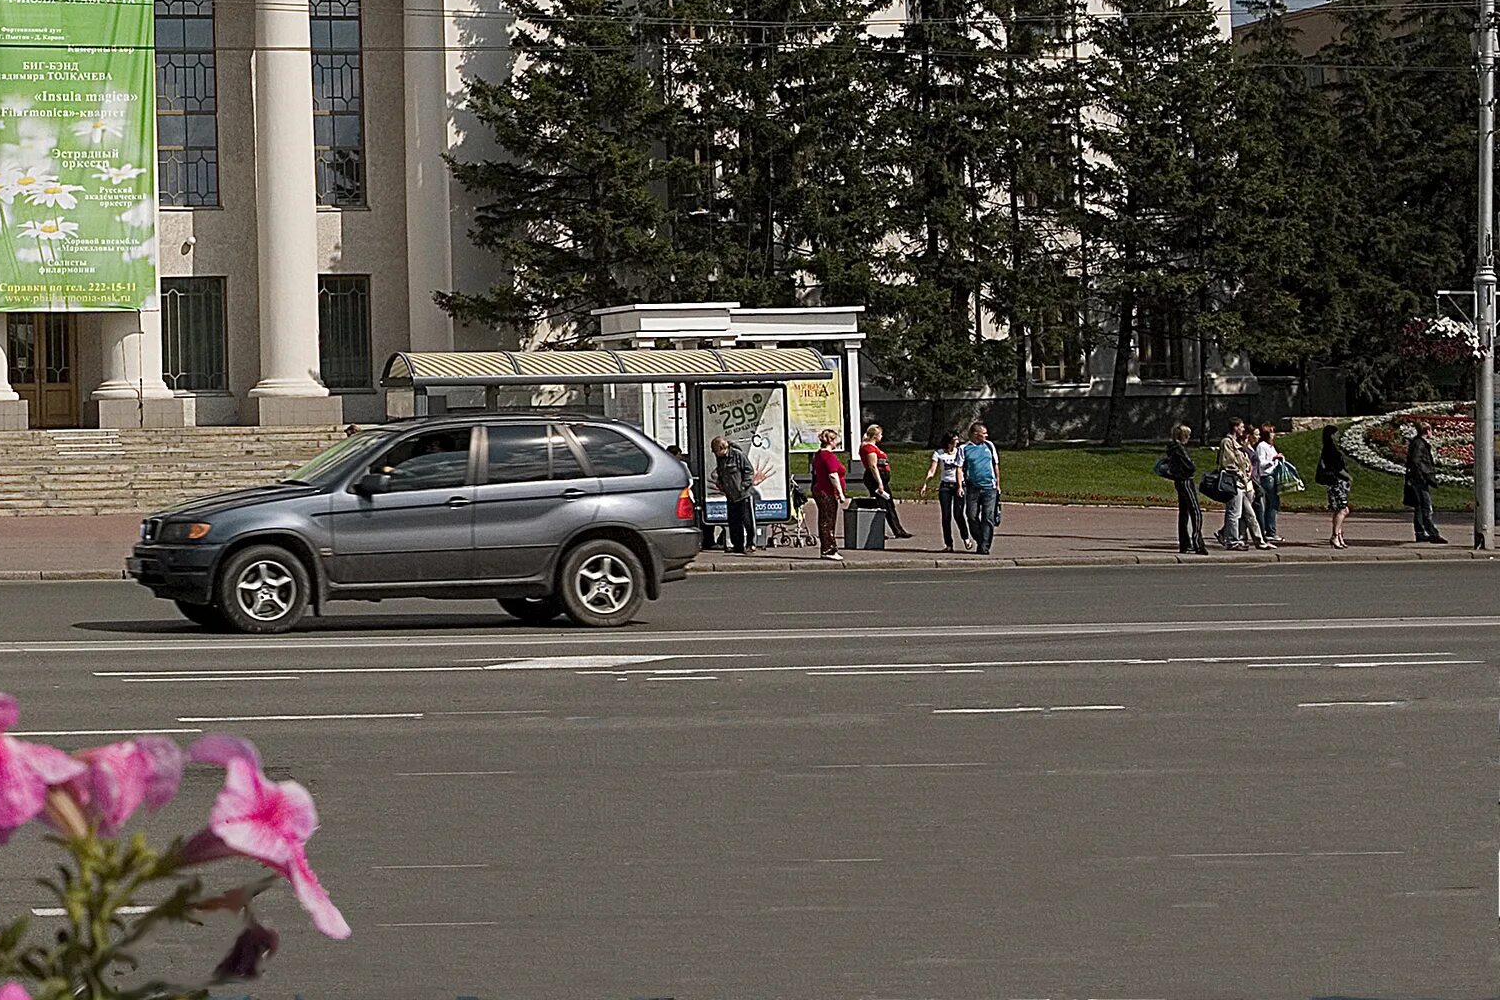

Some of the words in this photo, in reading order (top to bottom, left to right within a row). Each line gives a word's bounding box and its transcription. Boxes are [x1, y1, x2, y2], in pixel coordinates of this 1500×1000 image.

[22, 61, 79, 71] БИГ-БЭНД
[47, 72, 113, 81] ТОЛКАЧЕВА
[34, 91, 82, 102] «Insula
[85, 91, 139, 104] magica»
[52, 148, 120, 160] Эстрадный
[61, 159, 110, 170] оркестр
[99, 186, 133, 195] Русский
[84, 193, 147, 201] академический
[99, 200, 133, 208] оркестр
[64, 238, 99, 246] Хоровой
[101, 237, 140, 245] ансамбль
[47, 258, 88, 267] Солисты
[39, 266, 96, 275] филармонии
[50, 284, 62, 292] по
[65, 283, 86, 292] тел.
[89, 282, 137, 292] 222-15-11
[707, 403, 717, 414] 10
[719, 403, 758, 430] 299
